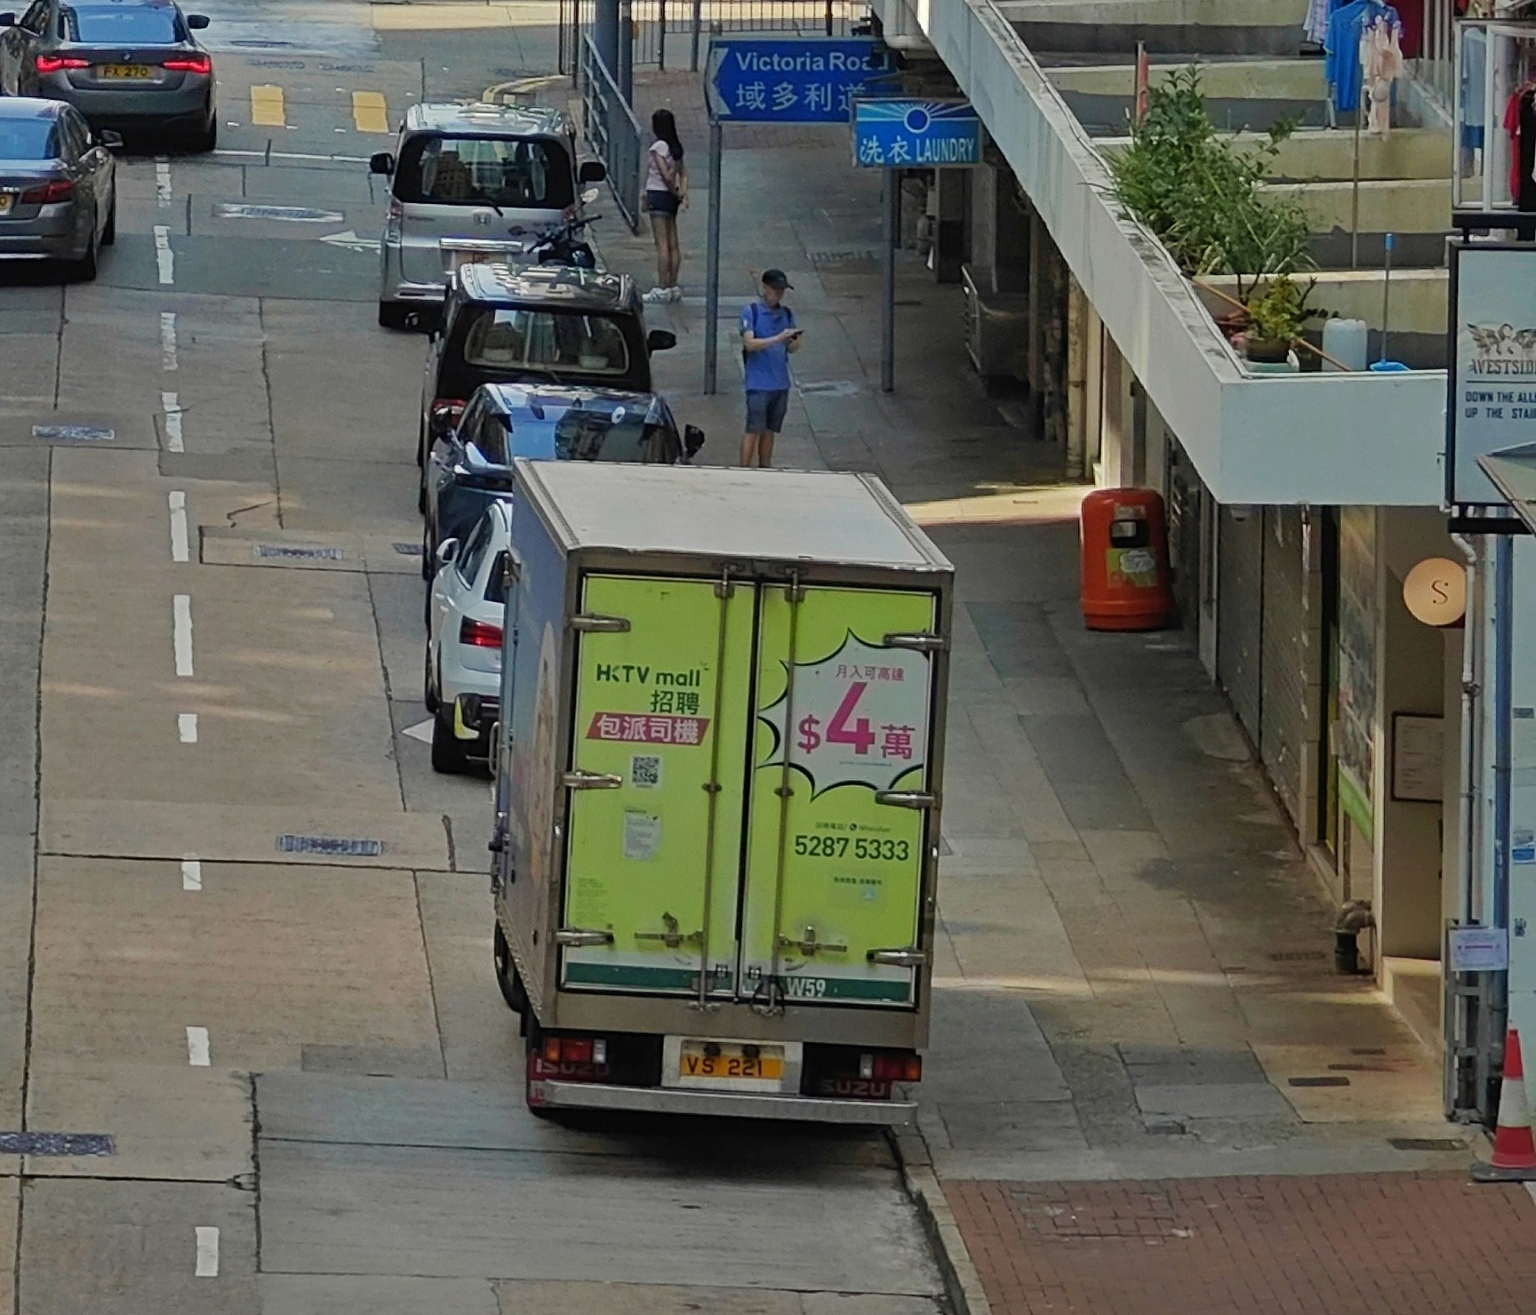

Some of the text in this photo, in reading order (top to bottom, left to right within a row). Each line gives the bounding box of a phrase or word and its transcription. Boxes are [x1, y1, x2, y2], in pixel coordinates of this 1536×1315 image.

[735, 51, 824, 71] Victoria
[735, 82, 867, 112] 域多利道
[860, 135, 975, 164] 洗衣 LAUNDRY
[1469, 358, 1536, 374] WESTSID
[1465, 391, 1536, 403] DOWN THE ALL
[1465, 407, 1478, 418] UP
[1486, 407, 1503, 419] THE
[1432, 579, 1449, 605] S
[596, 663, 701, 687] HKTV mall
[835, 664, 905, 682] 月入可高達
[650, 689, 700, 715] 招聘
[597, 714, 700, 744] 包派司機
[795, 835, 910, 861] 5287 5333
[787, 977, 827, 998] W59
[686, 1057, 763, 1078] VS 221
[820, 1078, 887, 1098] SUZU
